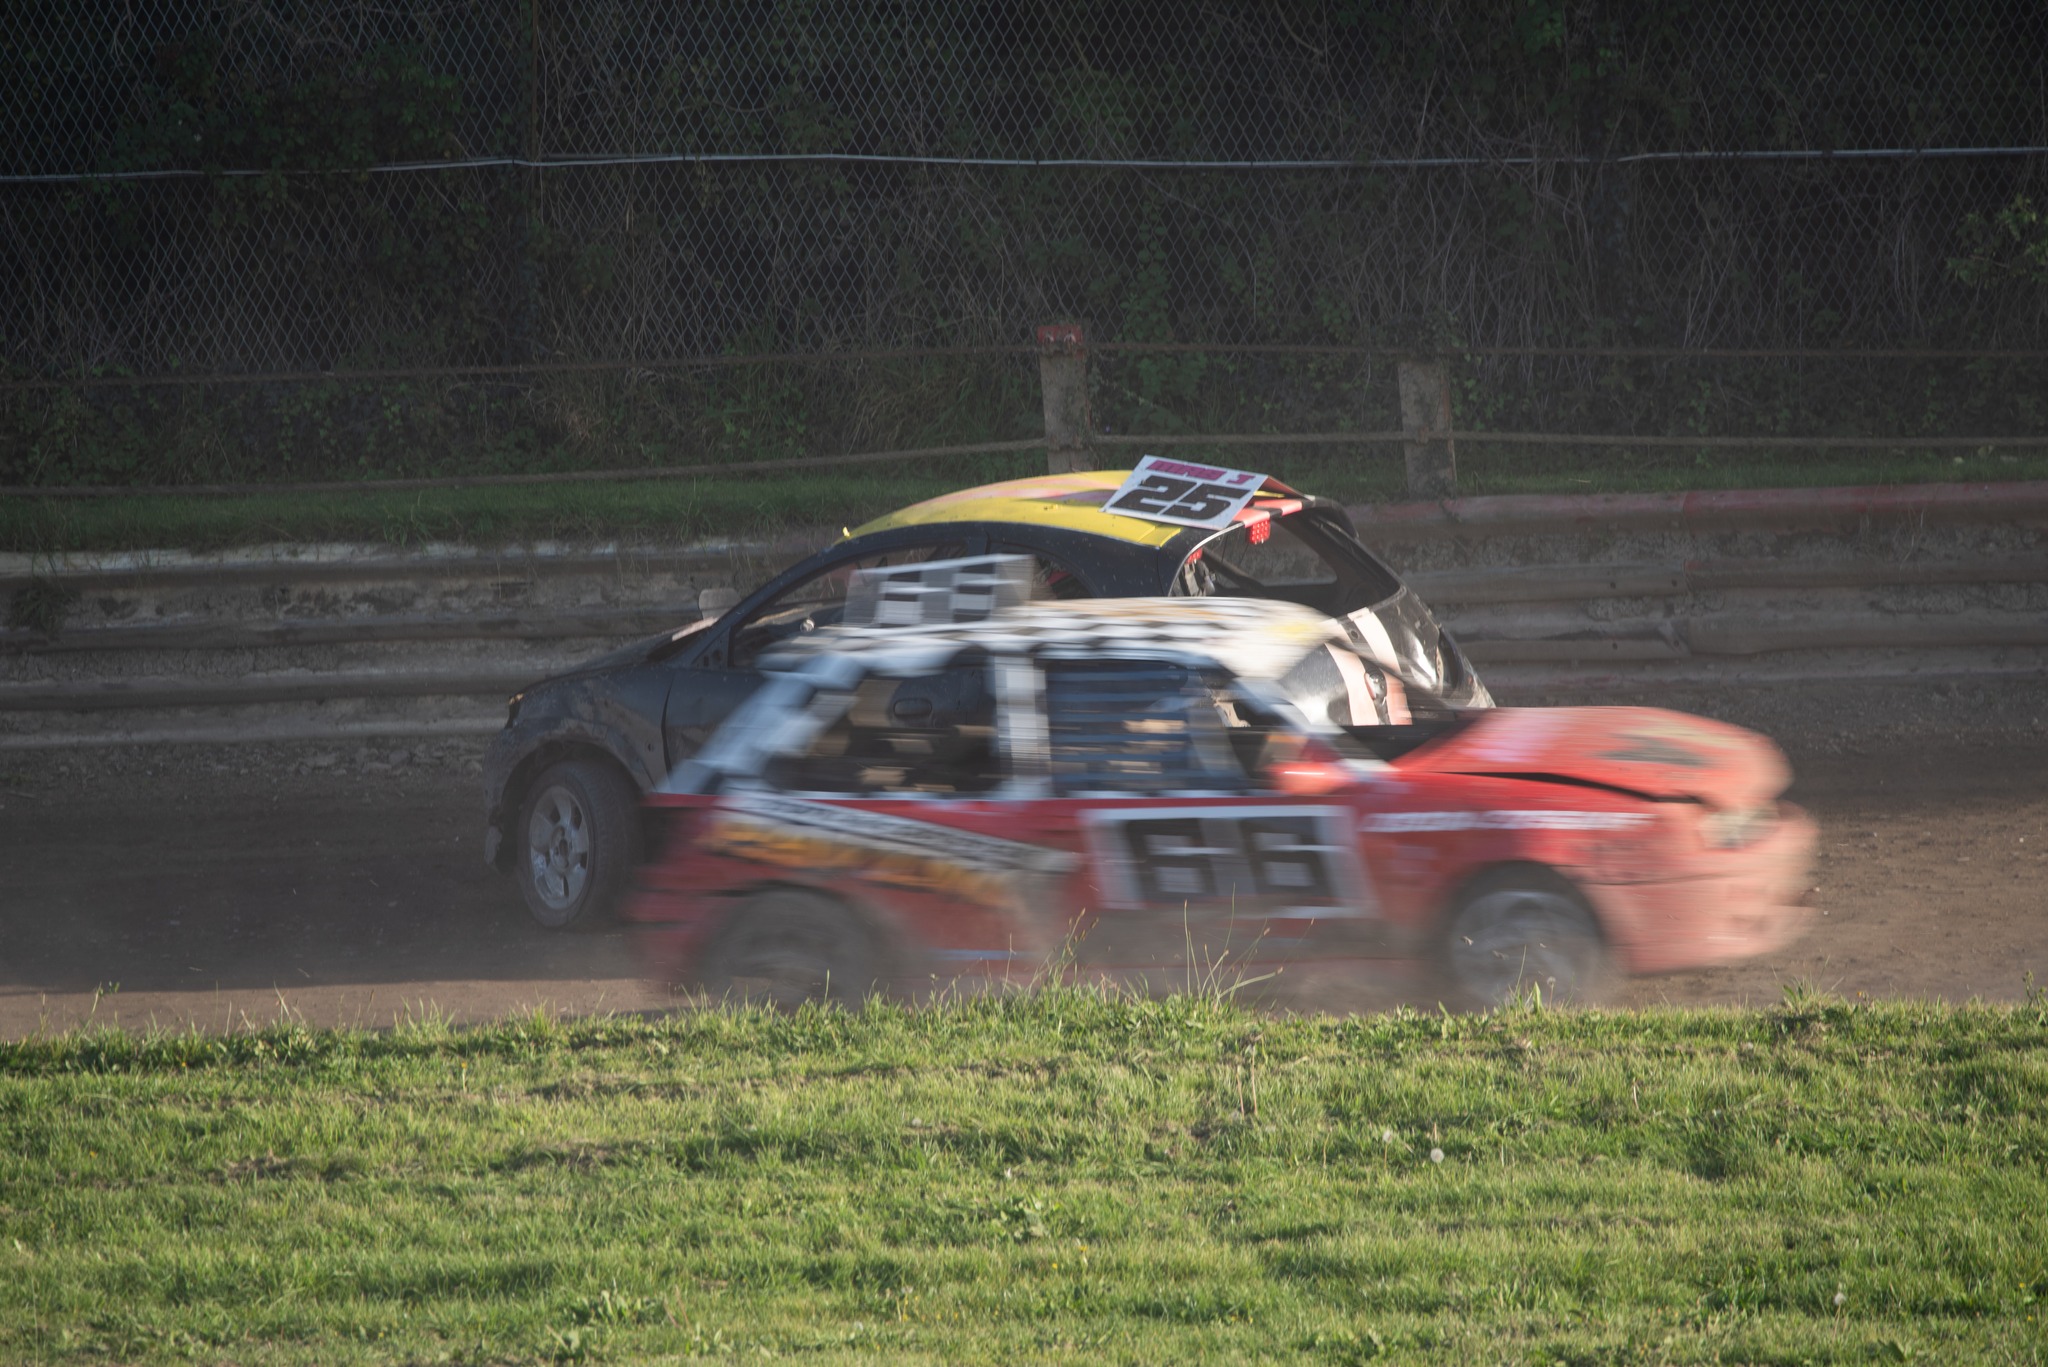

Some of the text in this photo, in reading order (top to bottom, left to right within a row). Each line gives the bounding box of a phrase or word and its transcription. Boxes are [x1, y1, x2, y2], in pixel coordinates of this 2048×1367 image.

[1110, 475, 1251, 521] 25
[1226, 473, 1256, 486] J
[1122, 815, 1342, 906] 66
